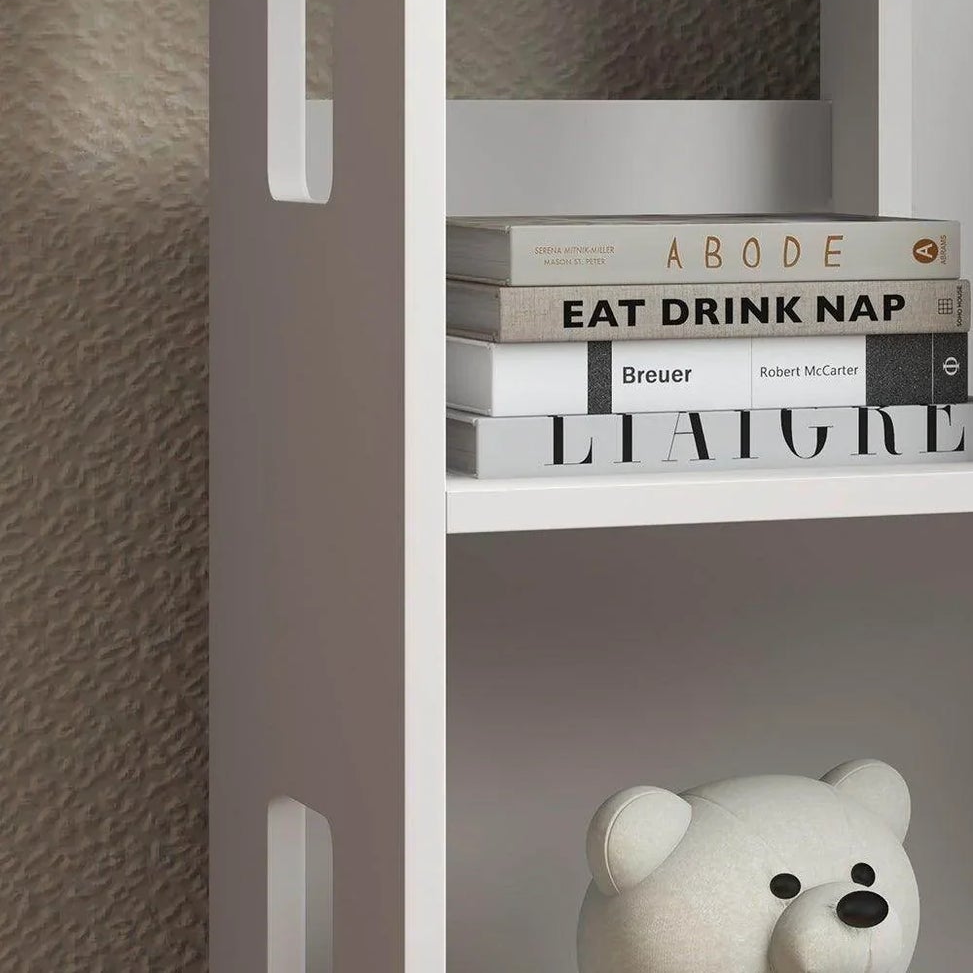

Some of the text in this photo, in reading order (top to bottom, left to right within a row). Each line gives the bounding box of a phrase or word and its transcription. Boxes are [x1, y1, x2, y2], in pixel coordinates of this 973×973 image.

[535, 246, 562, 255] SERENA
[667, 235, 843, 268] ABODE
[544, 258, 571, 266] MASON
[586, 257, 606, 266] PETER
[563, 293, 906, 328] EAT DRINK NAP
[622, 366, 692, 384] Breuer
[759, 364, 859, 378] Robert McCarter
